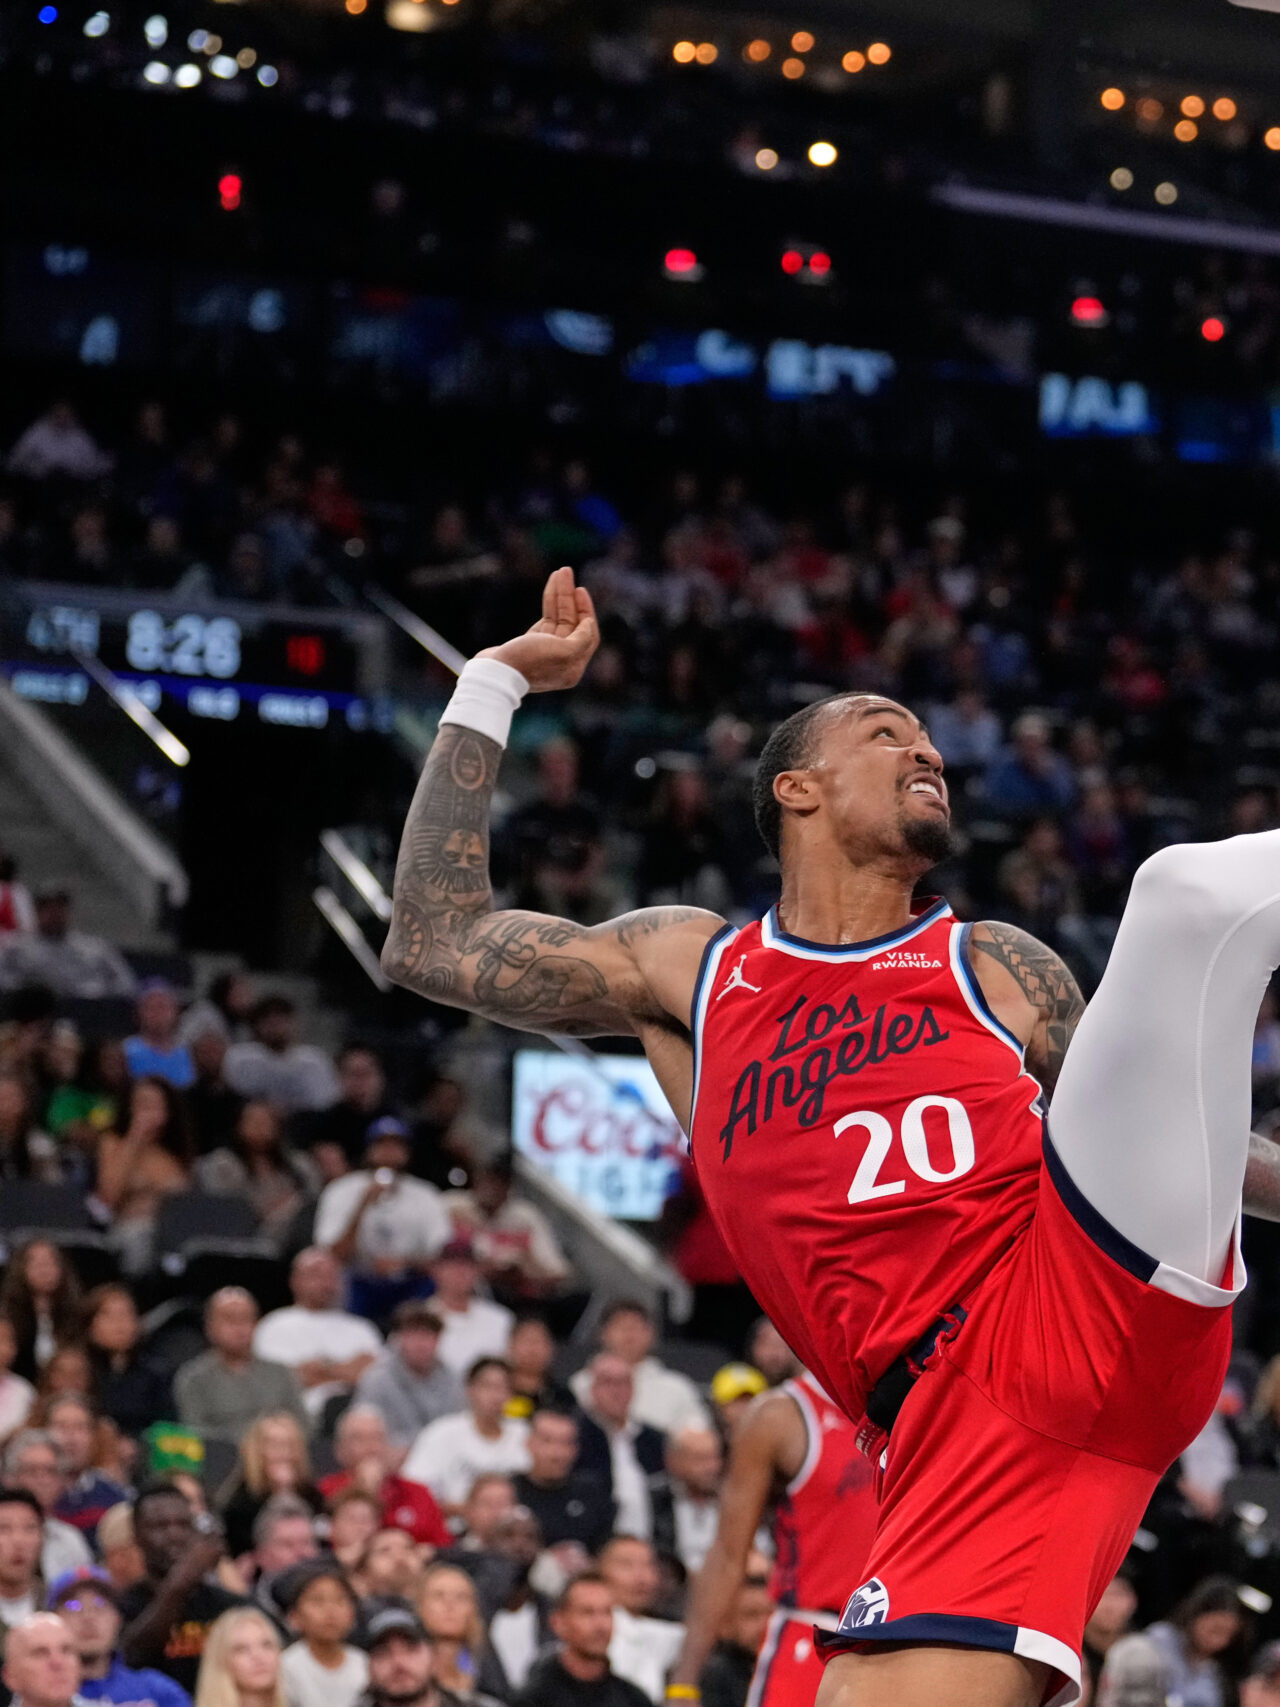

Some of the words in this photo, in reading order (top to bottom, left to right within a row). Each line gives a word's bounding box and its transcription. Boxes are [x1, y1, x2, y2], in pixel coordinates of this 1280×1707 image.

[872, 960, 943, 971] RWANDA
[886, 952, 926, 961] VISIT
[768, 994, 871, 1063] Los
[719, 1003, 950, 1164] Angeles
[832, 1094, 976, 1205] 20
